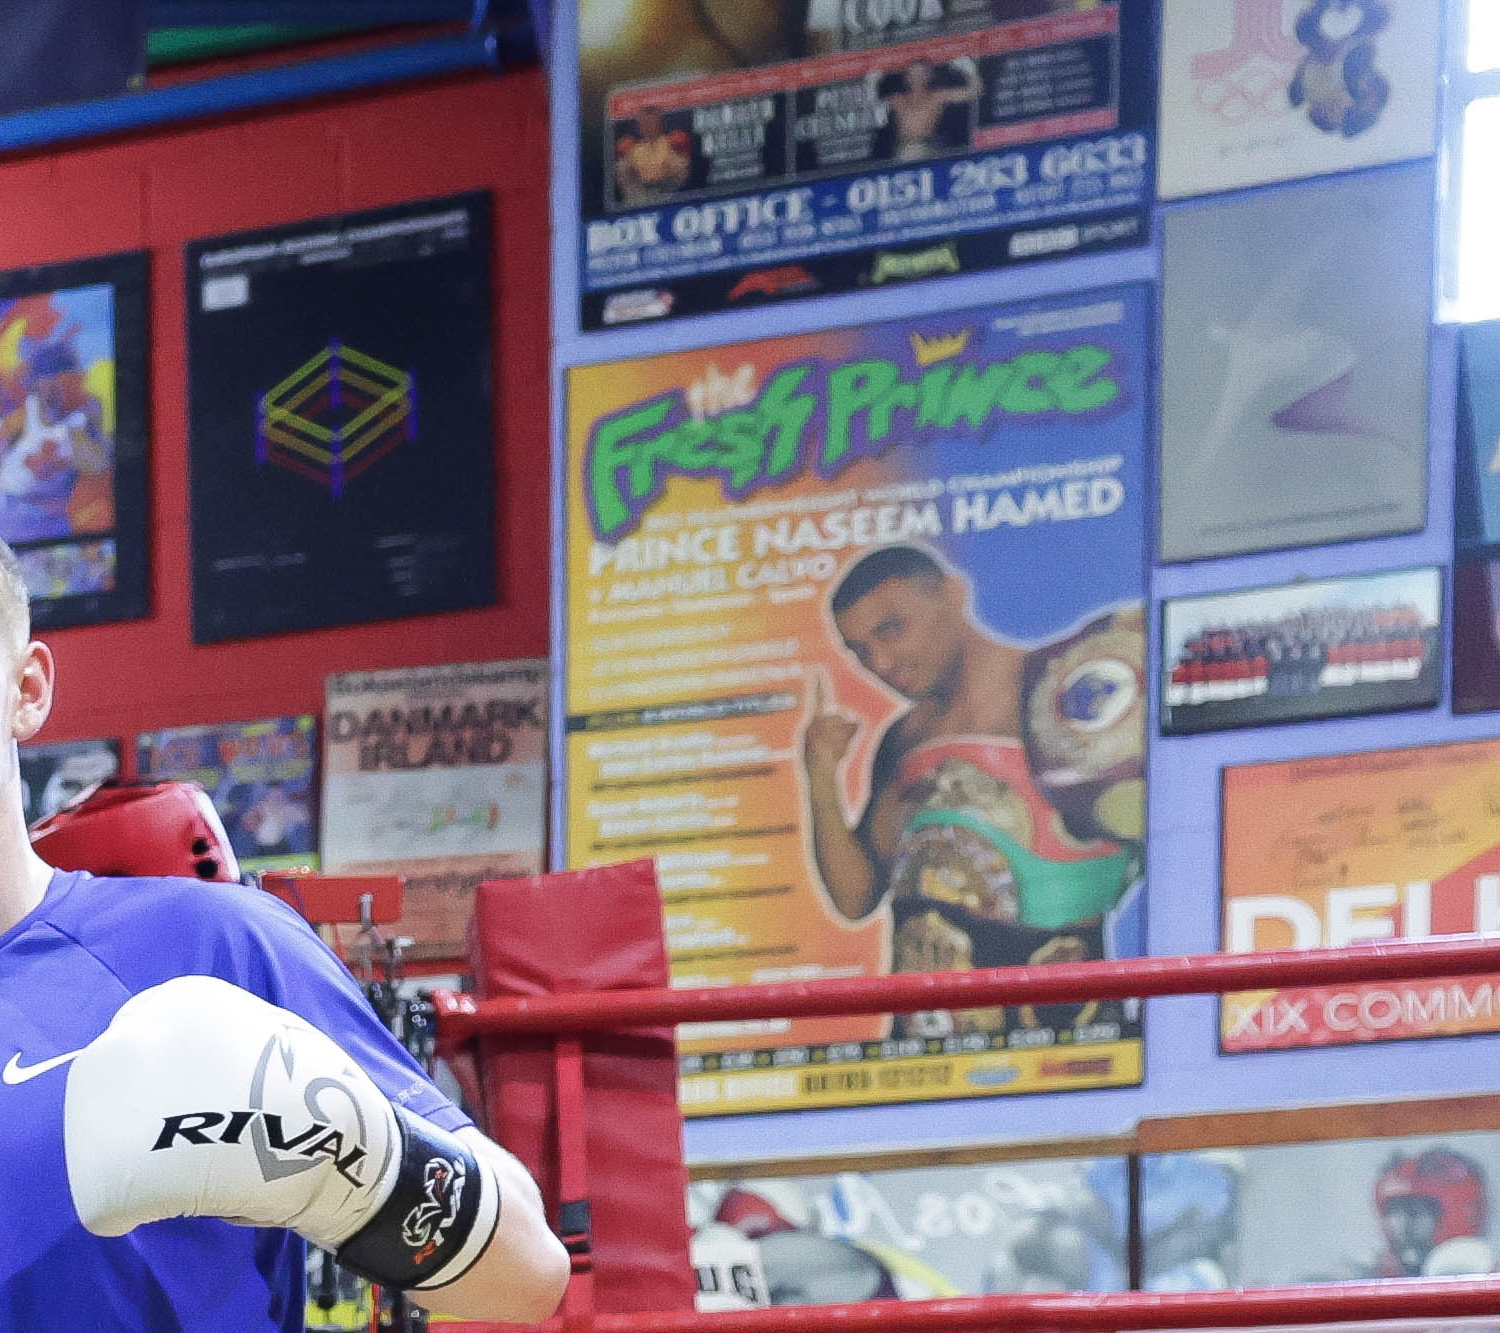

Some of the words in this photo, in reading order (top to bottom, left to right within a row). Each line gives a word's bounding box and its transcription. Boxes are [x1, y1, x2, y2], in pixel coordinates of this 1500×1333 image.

[588, 217, 660, 253] BOX
[673, 188, 812, 240] OFFICE
[589, 525, 741, 578] PRINCE
[754, 504, 943, 558] NASEEM
[953, 478, 1125, 532] HAMED
[736, 554, 838, 593] CALVO
[330, 698, 539, 741] DANMARK
[1228, 997, 1311, 1037] XIX
[1321, 980, 1500, 1032] COMM
[149, 1108, 369, 1191] RIVAL
